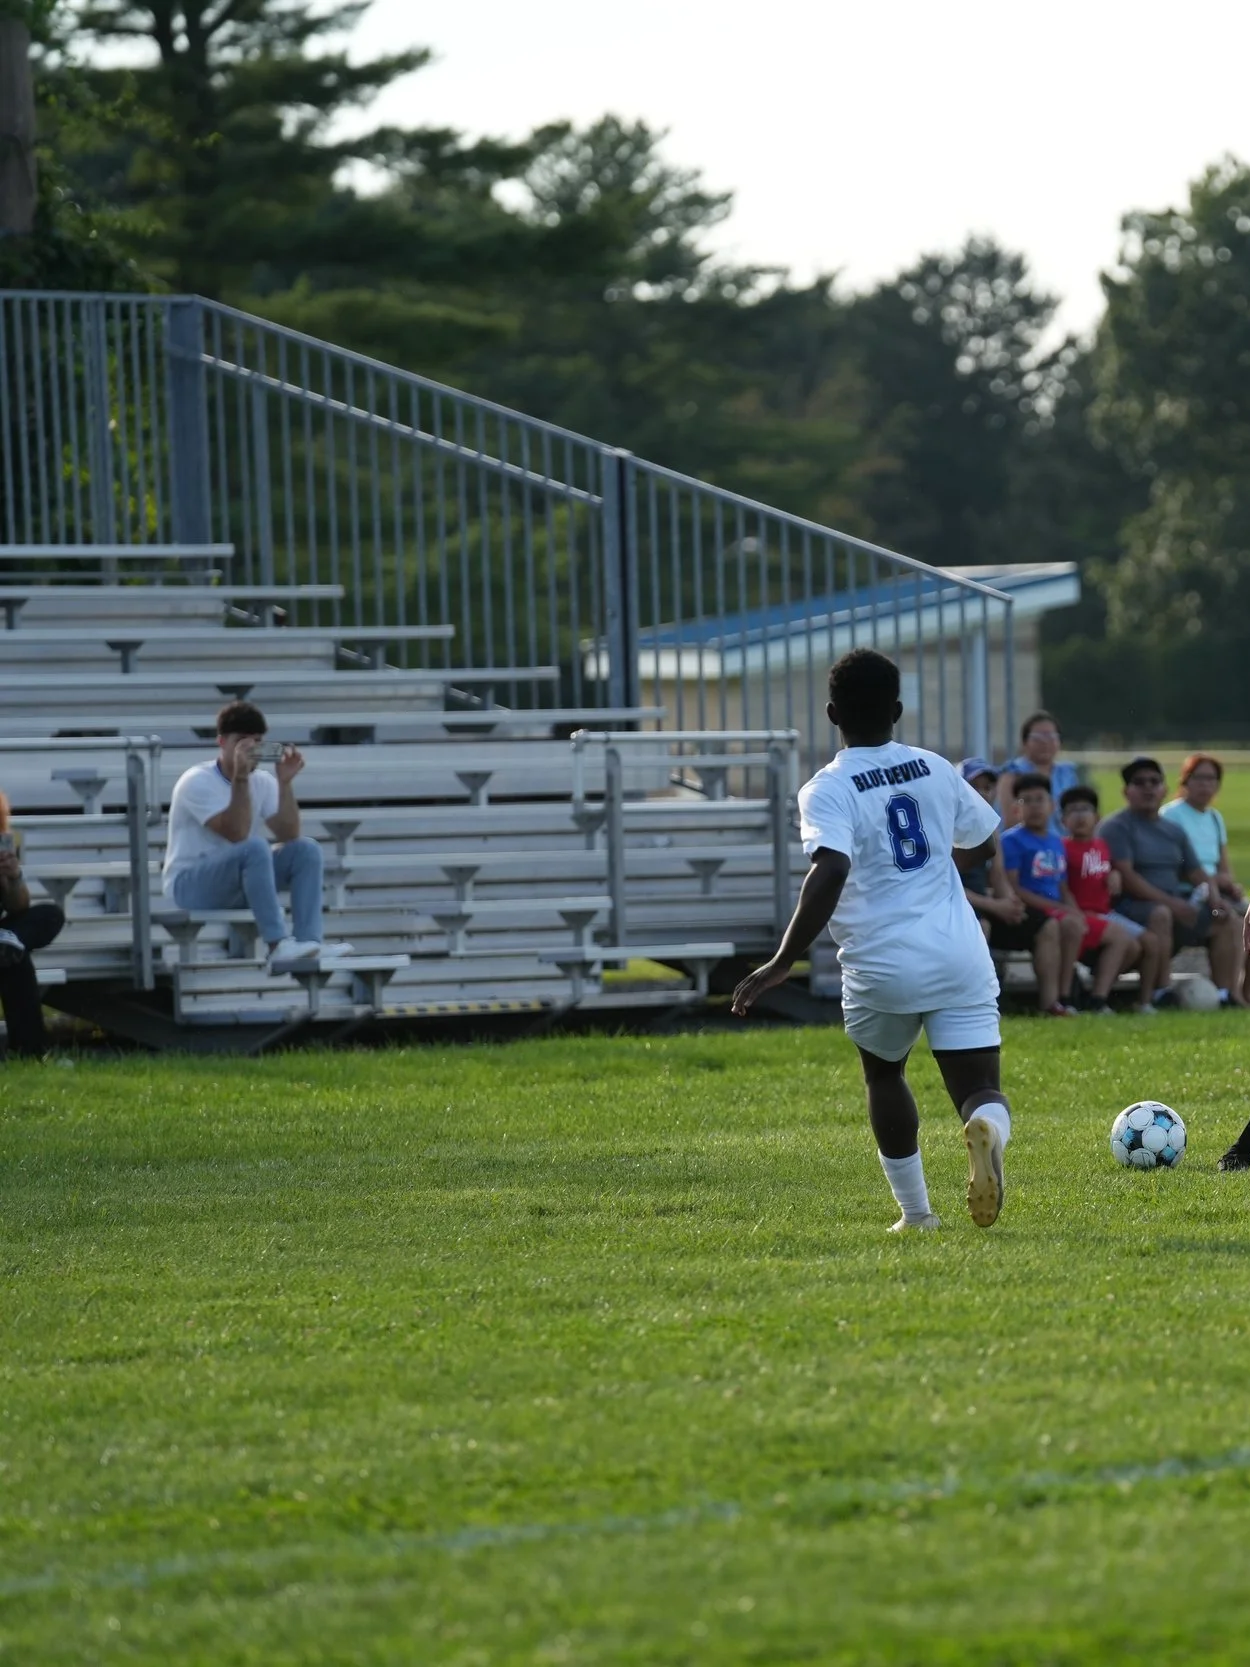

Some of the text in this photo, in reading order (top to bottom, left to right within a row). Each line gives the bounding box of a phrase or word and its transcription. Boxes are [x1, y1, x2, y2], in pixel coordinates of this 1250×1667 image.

[851, 758, 931, 793] BLUE DEVILS
[885, 793, 930, 872] 8
